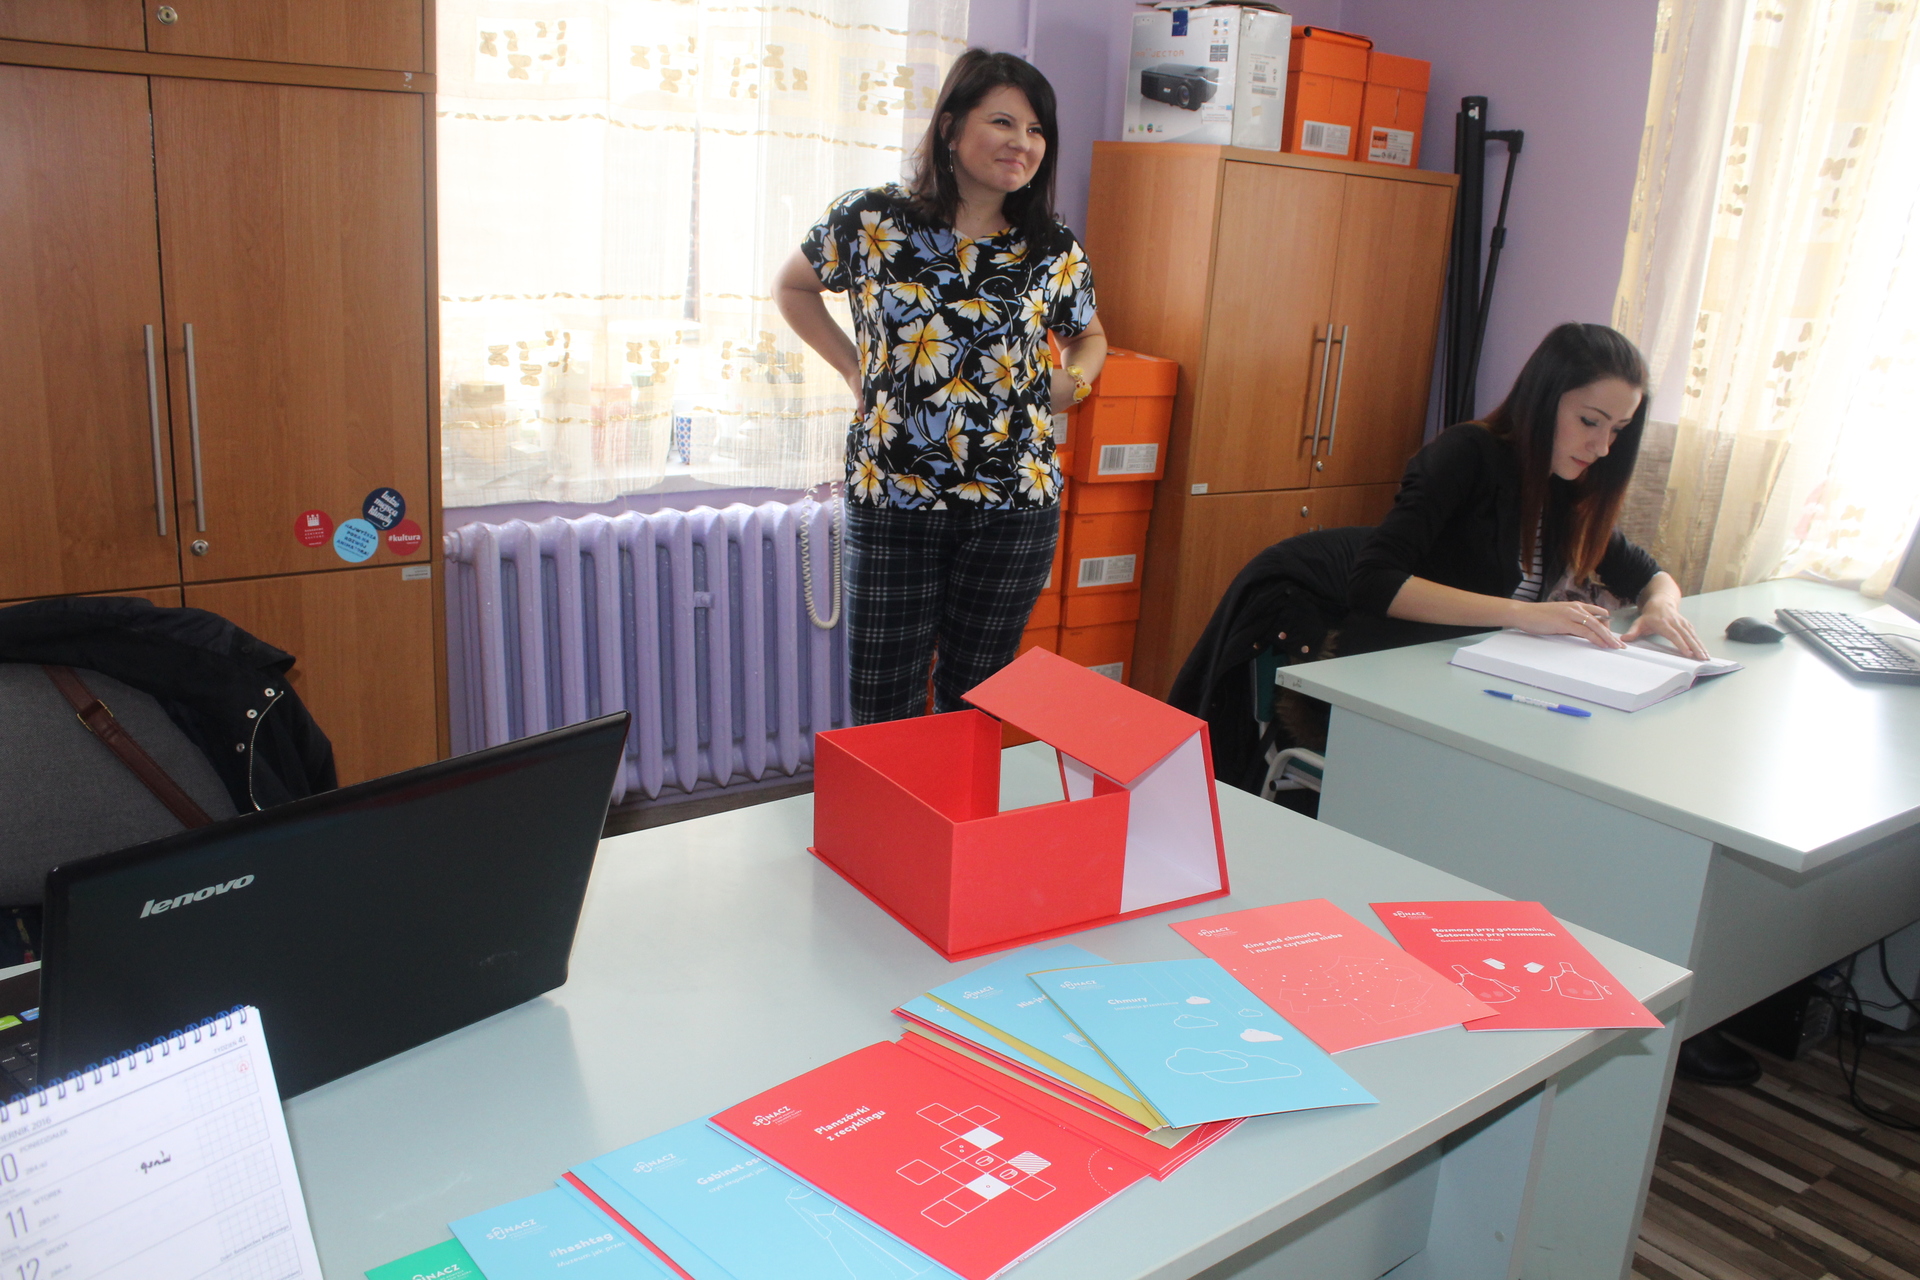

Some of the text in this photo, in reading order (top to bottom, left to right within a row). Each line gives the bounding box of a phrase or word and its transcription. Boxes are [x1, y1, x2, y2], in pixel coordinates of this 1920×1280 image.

[388, 534, 421, 542] #kultura
[140, 874, 255, 919] lenovo
[1242, 941, 1265, 950] Kino
[1266, 937, 1283, 946] pod
[1255, 945, 1283, 954] nocne
[1283, 937, 1319, 948] czytanie
[1319, 932, 1343, 942] nieba
[1060, 980, 1098, 990] SPINACZ
[1107, 997, 1149, 1006] Chmury
[237, 1035, 247, 1045] 41
[752, 1105, 792, 1126] SPINACZ
[814, 1105, 871, 1135] Planszówki
[834, 1109, 887, 1138] recyklingu
[0, 1153, 19, 1186] 0
[632, 1153, 677, 1173] SPINACZ
[696, 1164, 745, 1185] Gabinet
[6, 1206, 28, 1238] 11
[485, 1218, 538, 1240] SPINACZ
[548, 1232, 614, 1258] #hashtag
[16, 1257, 40, 1280] 12
[556, 1253, 591, 1268] Muzeum
